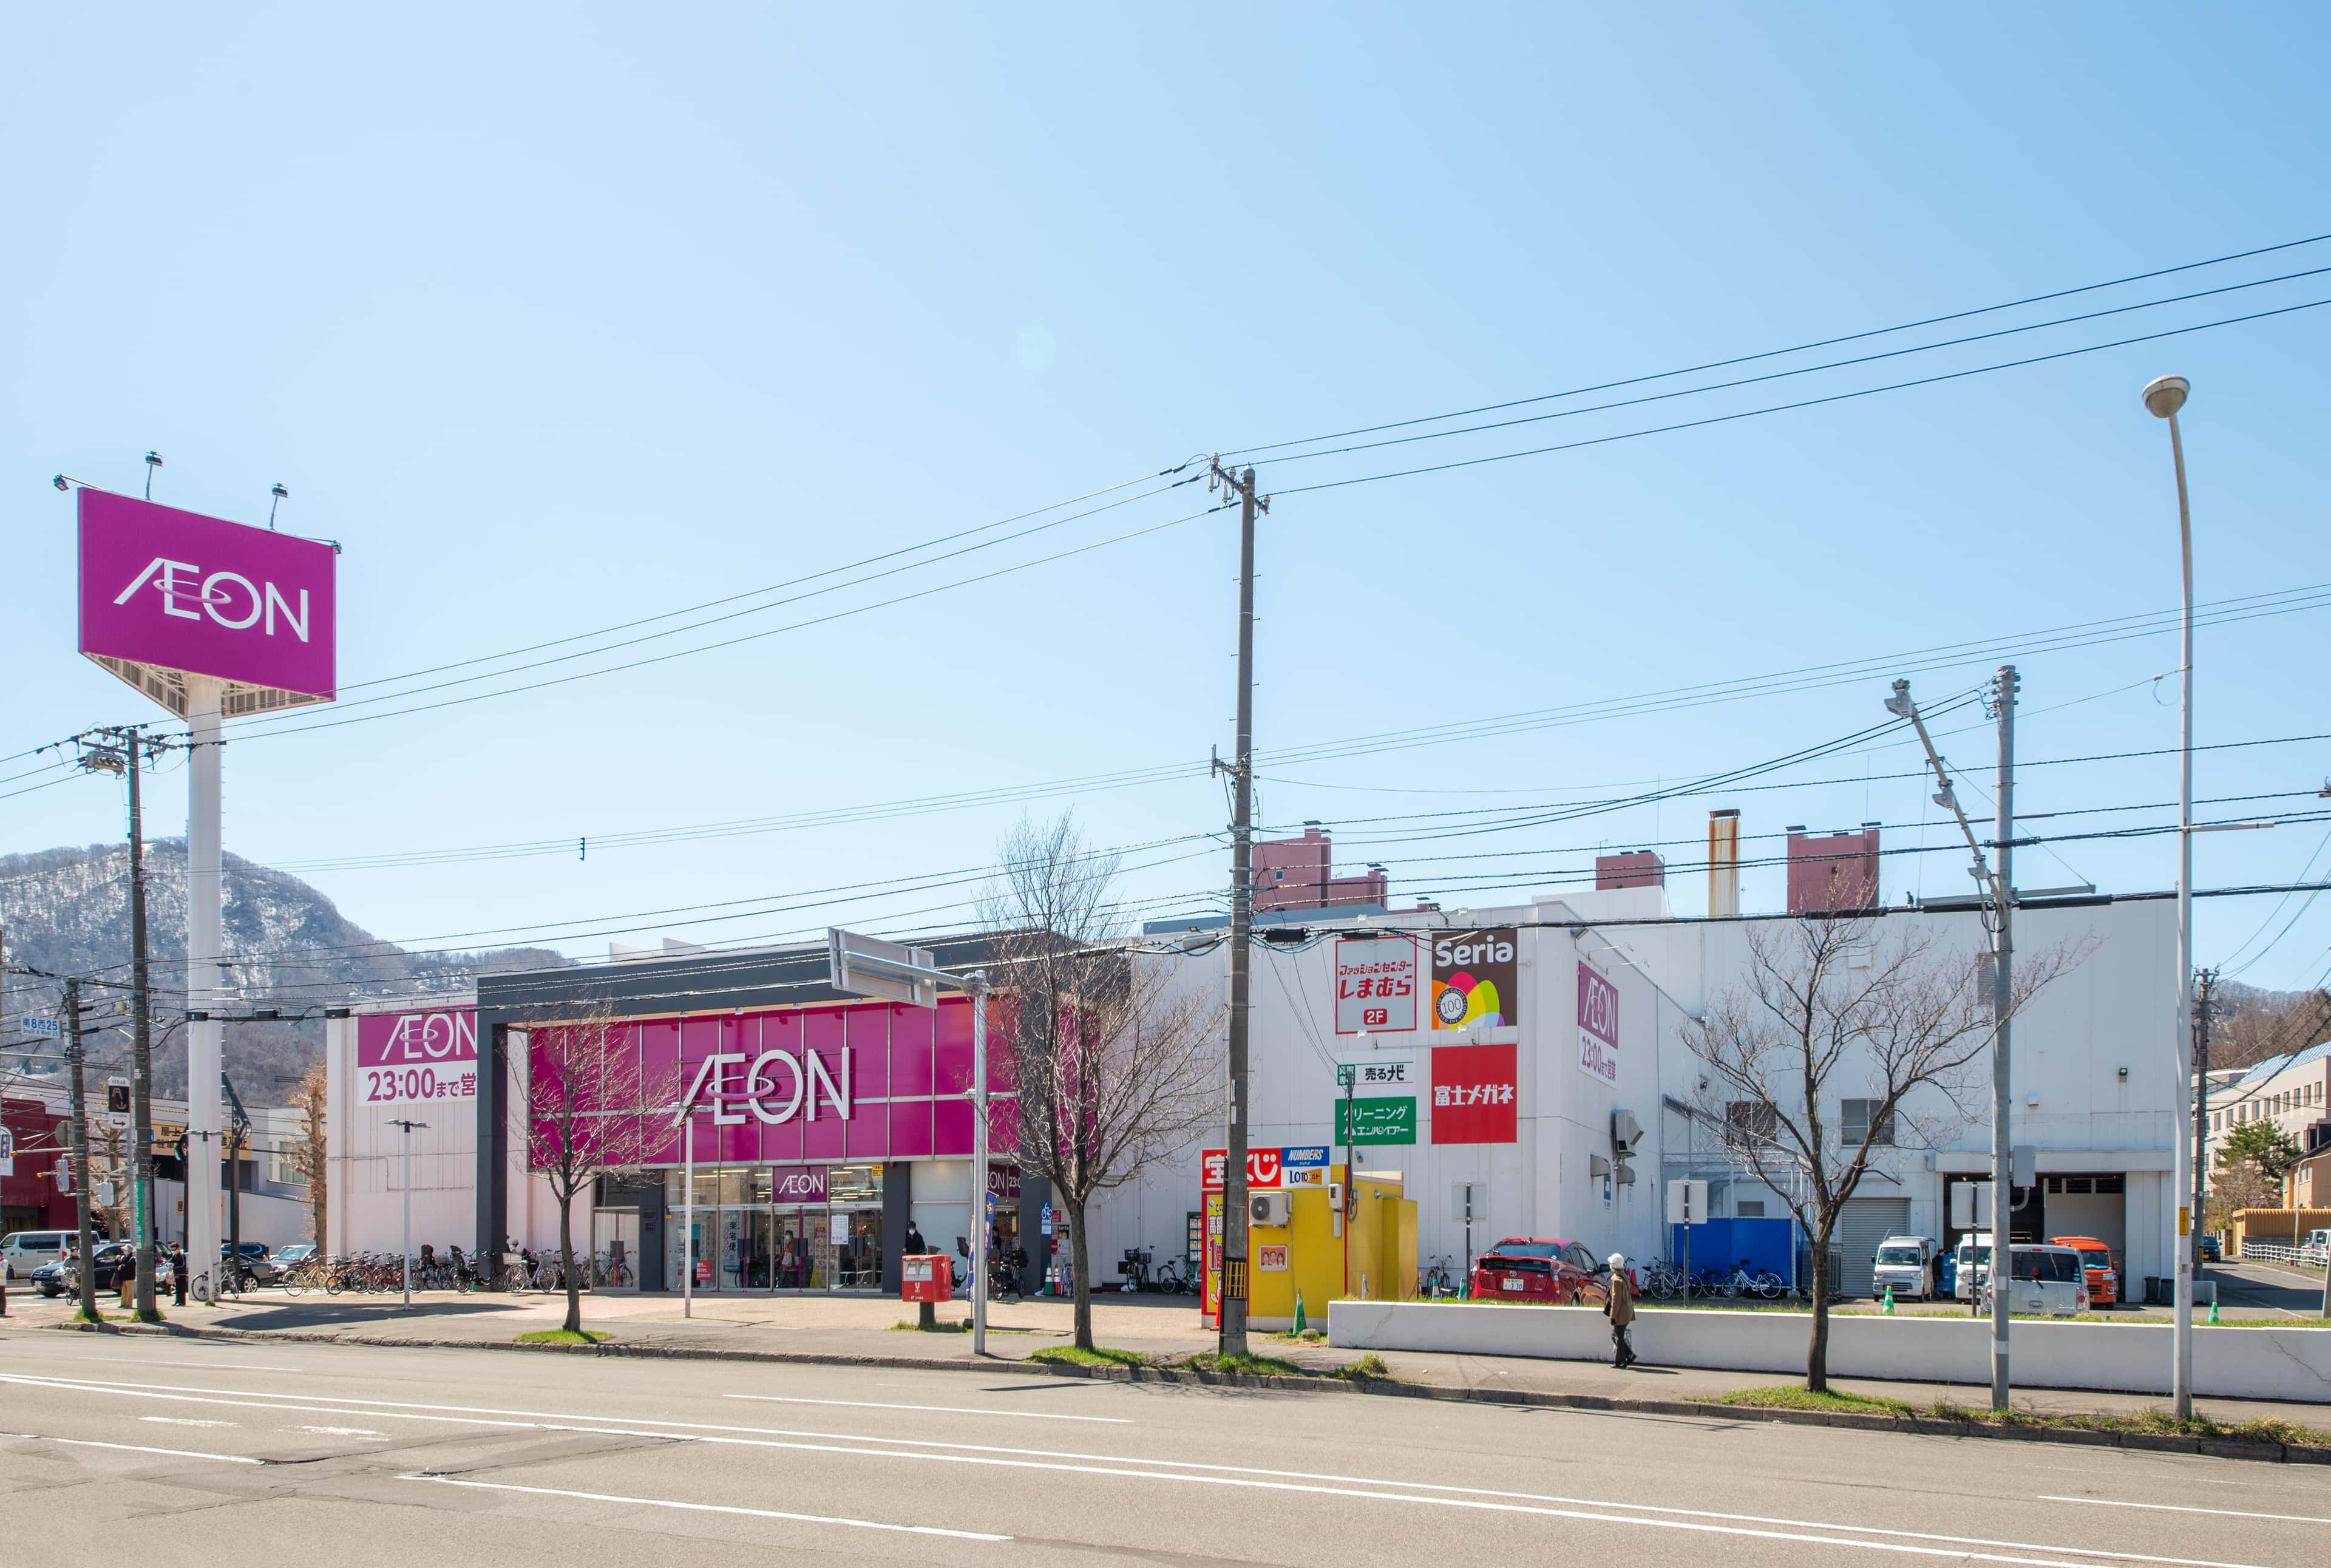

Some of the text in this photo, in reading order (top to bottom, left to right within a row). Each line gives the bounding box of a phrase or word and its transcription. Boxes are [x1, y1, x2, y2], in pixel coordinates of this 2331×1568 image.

[1436, 935, 1513, 967] Seria
[1340, 961, 1413, 976] ファッションセンター
[1340, 975, 1413, 1000] しまむら
[1442, 998, 1462, 1014] 100
[22, 1017, 58, 1031] 南8西25
[1367, 1011, 1383, 1023] 2F
[1365, 1064, 1404, 1082] 売るナビ
[1434, 1084, 1515, 1106] 富士メガネ
[1288, 1149, 1323, 1161] NUMBERS
[1289, 1170, 1308, 1183] LOTO
